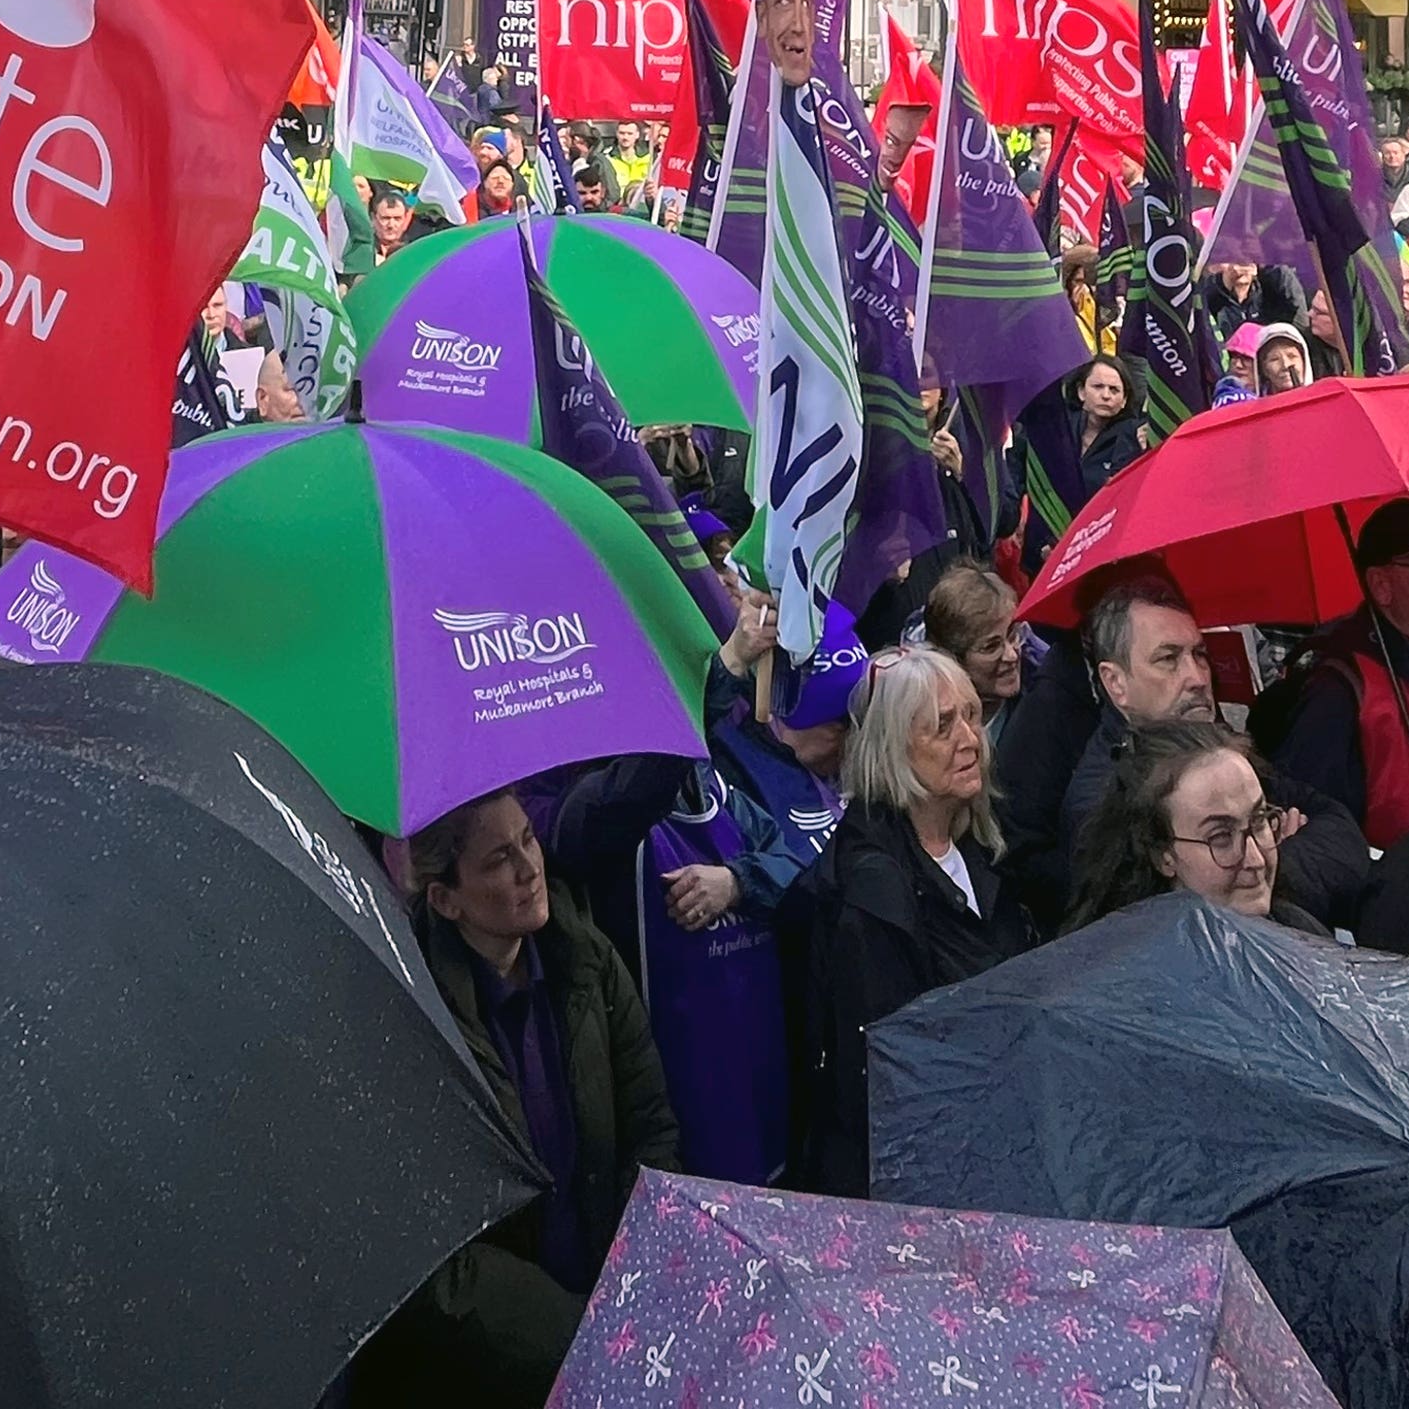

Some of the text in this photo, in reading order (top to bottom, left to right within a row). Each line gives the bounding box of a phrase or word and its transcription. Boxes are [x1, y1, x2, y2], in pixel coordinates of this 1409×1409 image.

[850, 285, 905, 330] public
[411, 336, 503, 368] UNISON
[6, 587, 81, 647] UNISON
[453, 611, 587, 671] UNISON
[473, 681, 518, 714] Royal
[518, 658, 580, 694] Hospitals
[473, 680, 605, 724] Muckamore Branch
